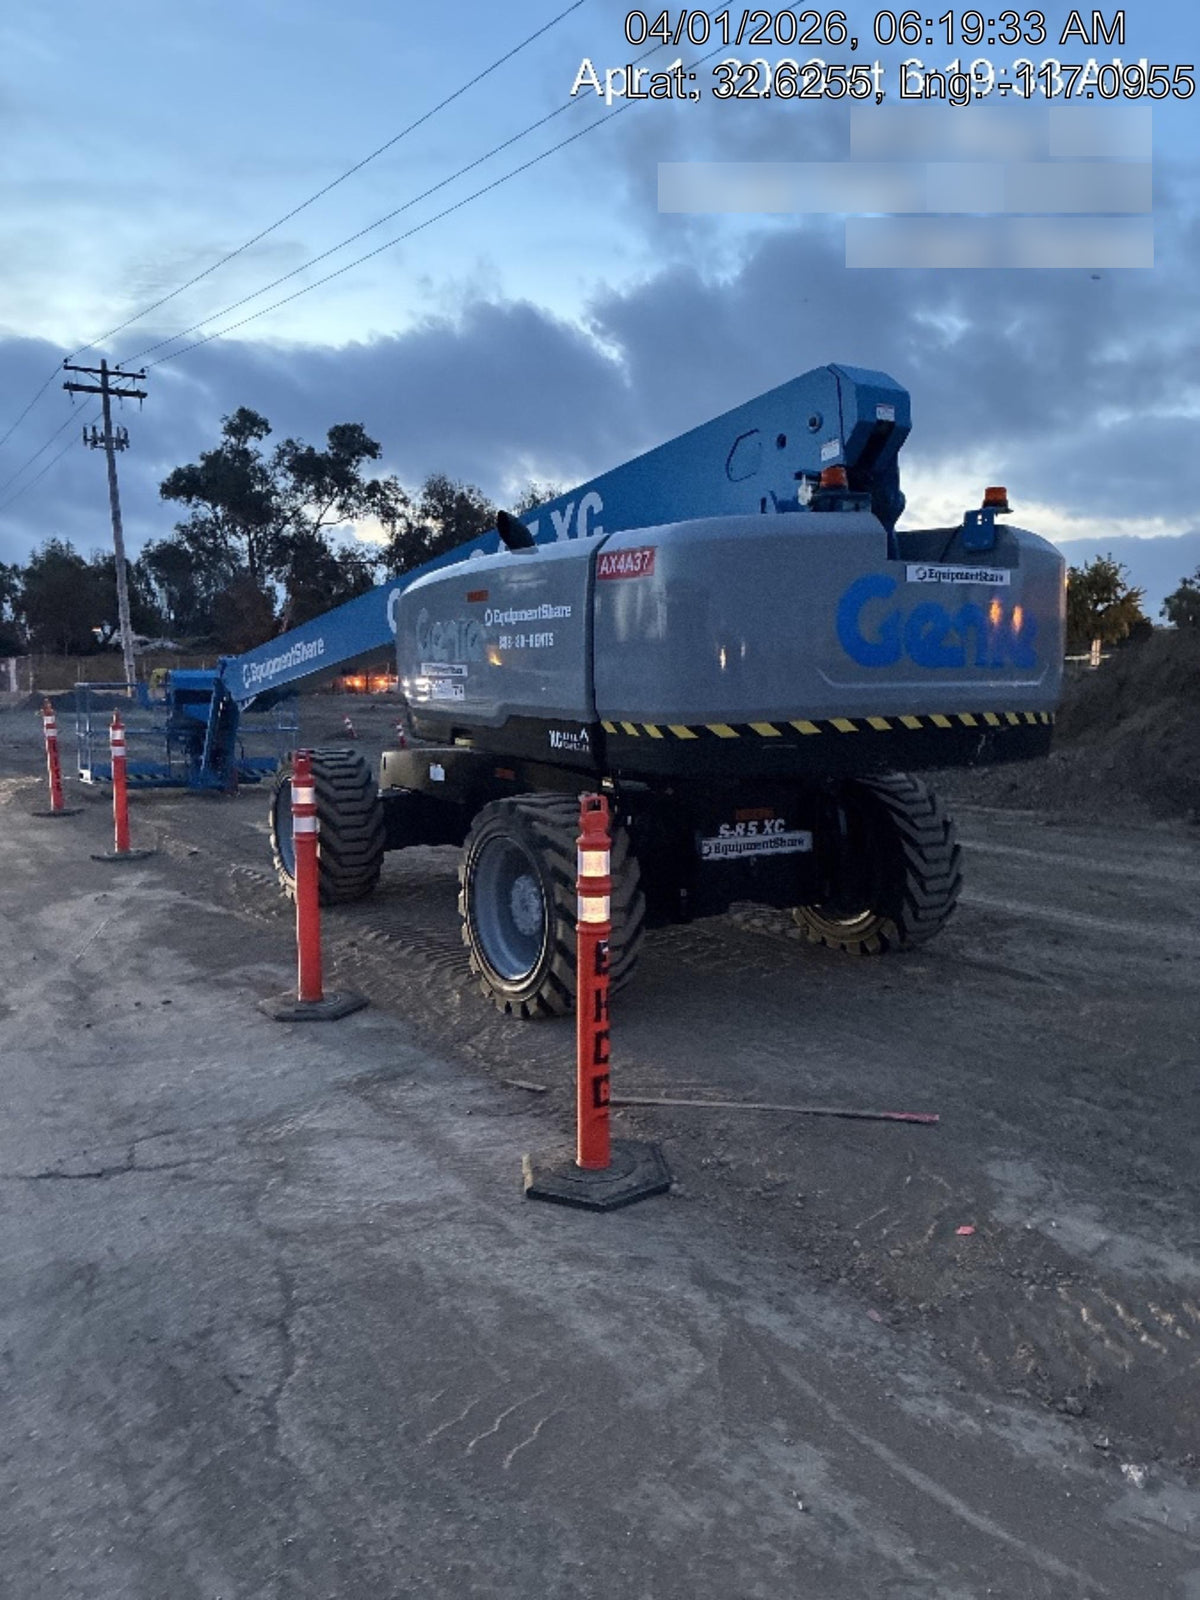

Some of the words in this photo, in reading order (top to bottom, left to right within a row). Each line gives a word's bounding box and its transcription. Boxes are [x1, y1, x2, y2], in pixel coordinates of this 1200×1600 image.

[600, 550, 651, 575] AX4A37
[249, 637, 325, 684] EquipmentShare
[718, 820, 759, 839] S-85
[762, 818, 786, 836] XC
